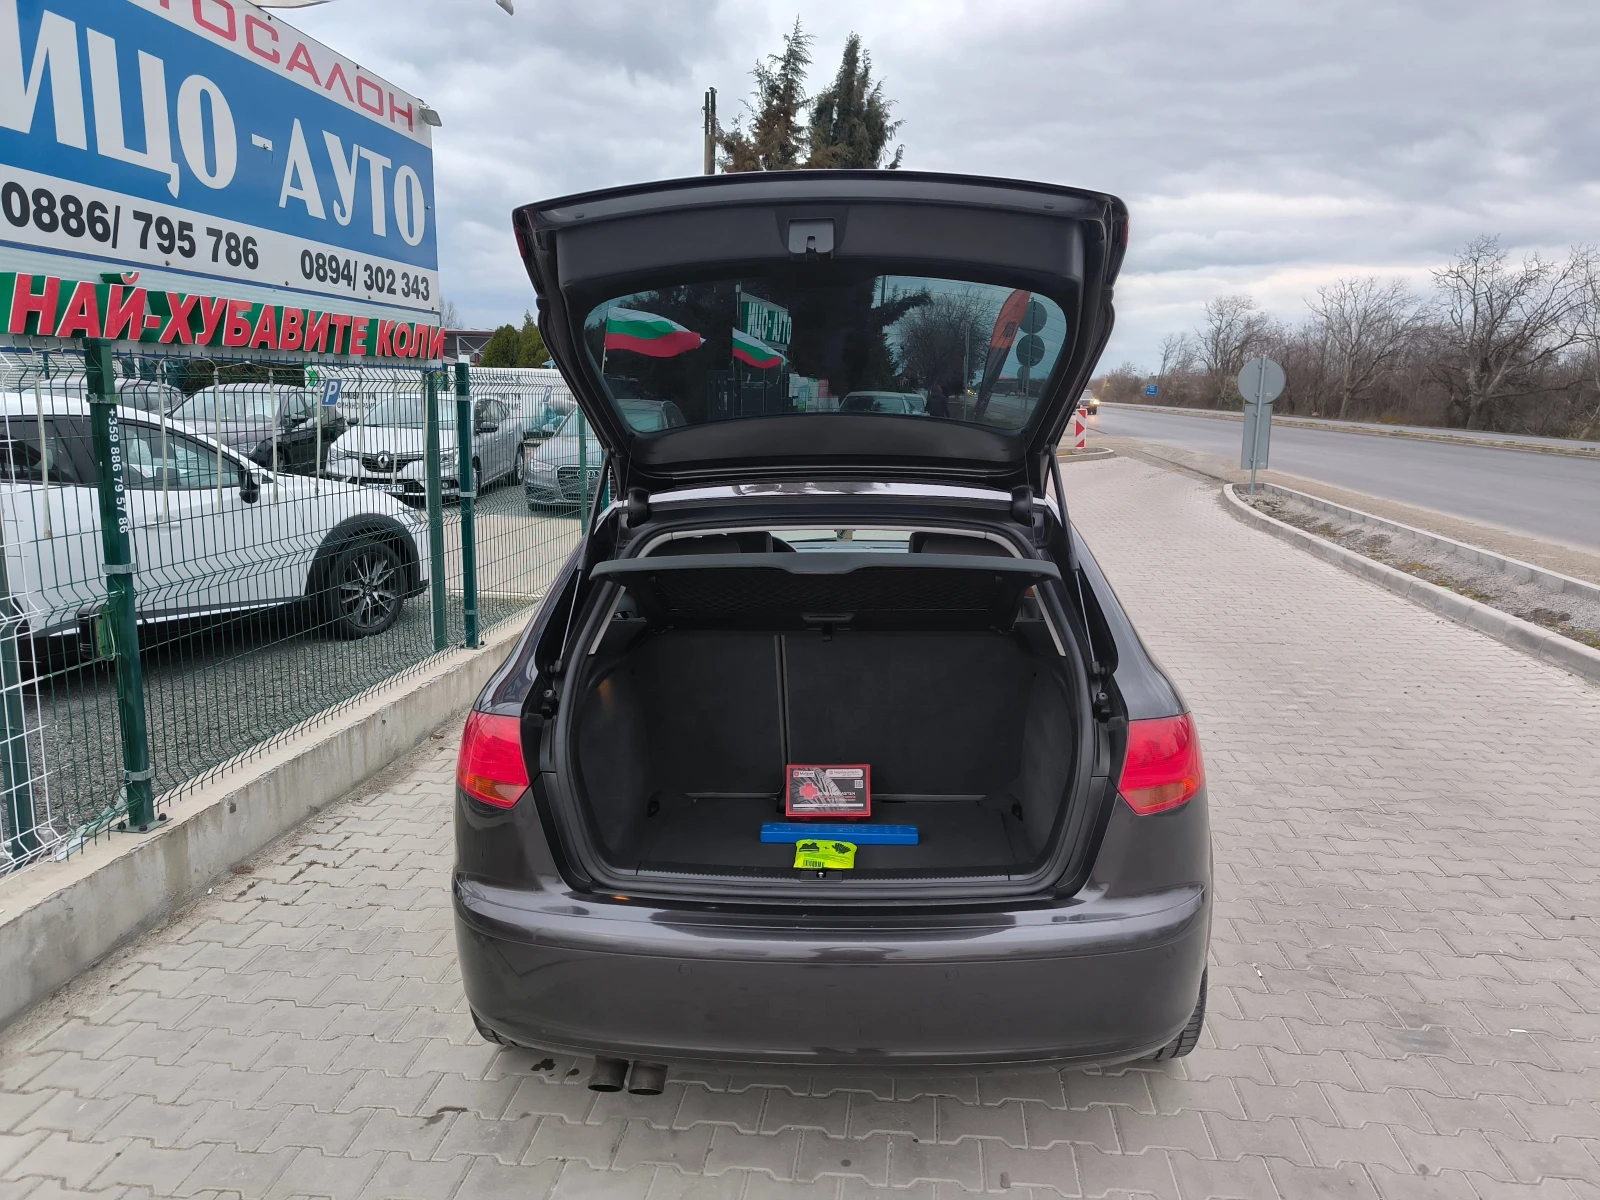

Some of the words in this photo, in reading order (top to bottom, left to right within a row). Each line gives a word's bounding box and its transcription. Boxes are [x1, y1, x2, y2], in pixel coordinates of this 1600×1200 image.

[160, 0, 414, 132] ОСАЛОН
[1, 181, 120, 249] 0886/
[133, 210, 196, 259] 795
[206, 228, 259, 270] 786
[300, 249, 359, 291] 0894/
[363, 264, 397, 295] 302
[401, 273, 430, 302] 343
[8, 271, 368, 355] НАЙ-ХУБАВИТЕ
[377, 319, 446, 360] КОЛИ
[108, 408, 119, 443] +359
[111, 446, 122, 472] 886
[113, 475, 124, 493] 79
[116, 497, 127, 513] 57
[118, 517, 129, 534] 86
